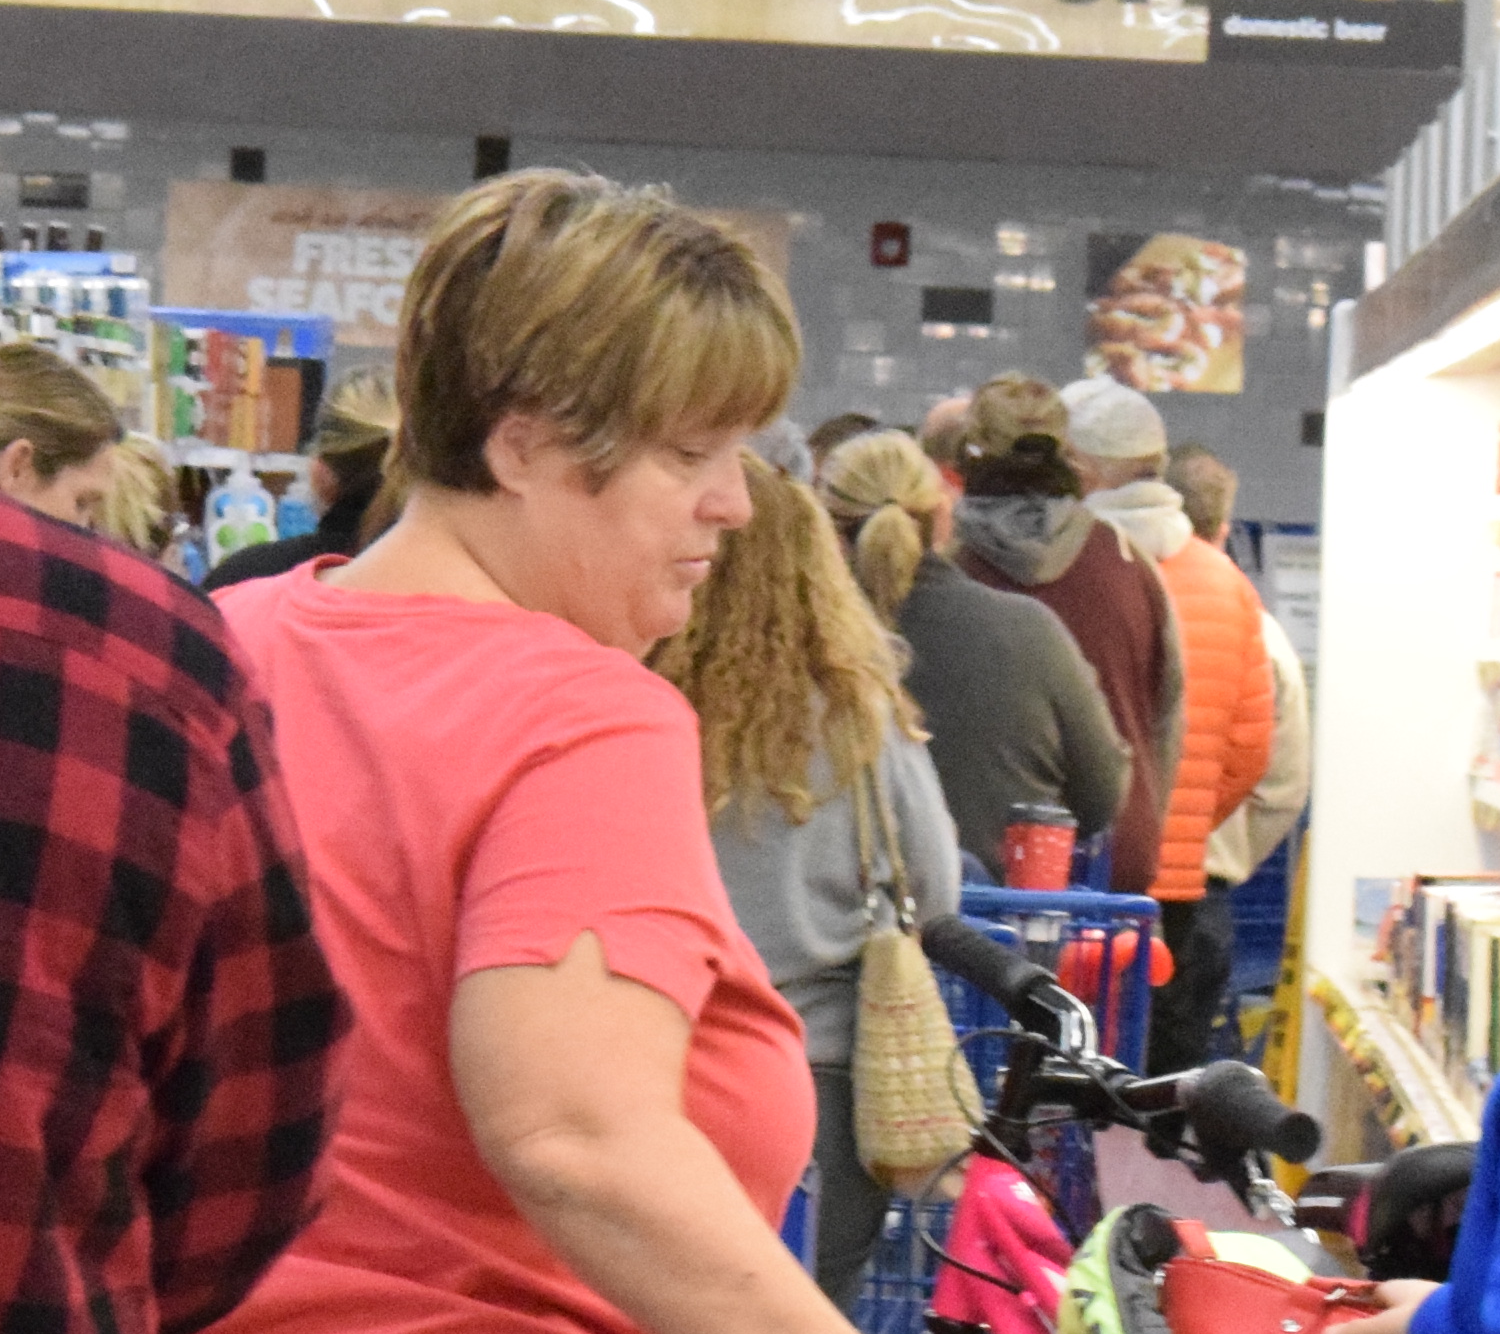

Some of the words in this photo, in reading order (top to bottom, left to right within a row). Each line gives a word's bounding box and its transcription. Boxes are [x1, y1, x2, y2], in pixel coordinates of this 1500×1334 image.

[1221, 14, 1330, 40] domestic
[1333, 17, 1388, 43] beer
[292, 231, 428, 278] FRES
